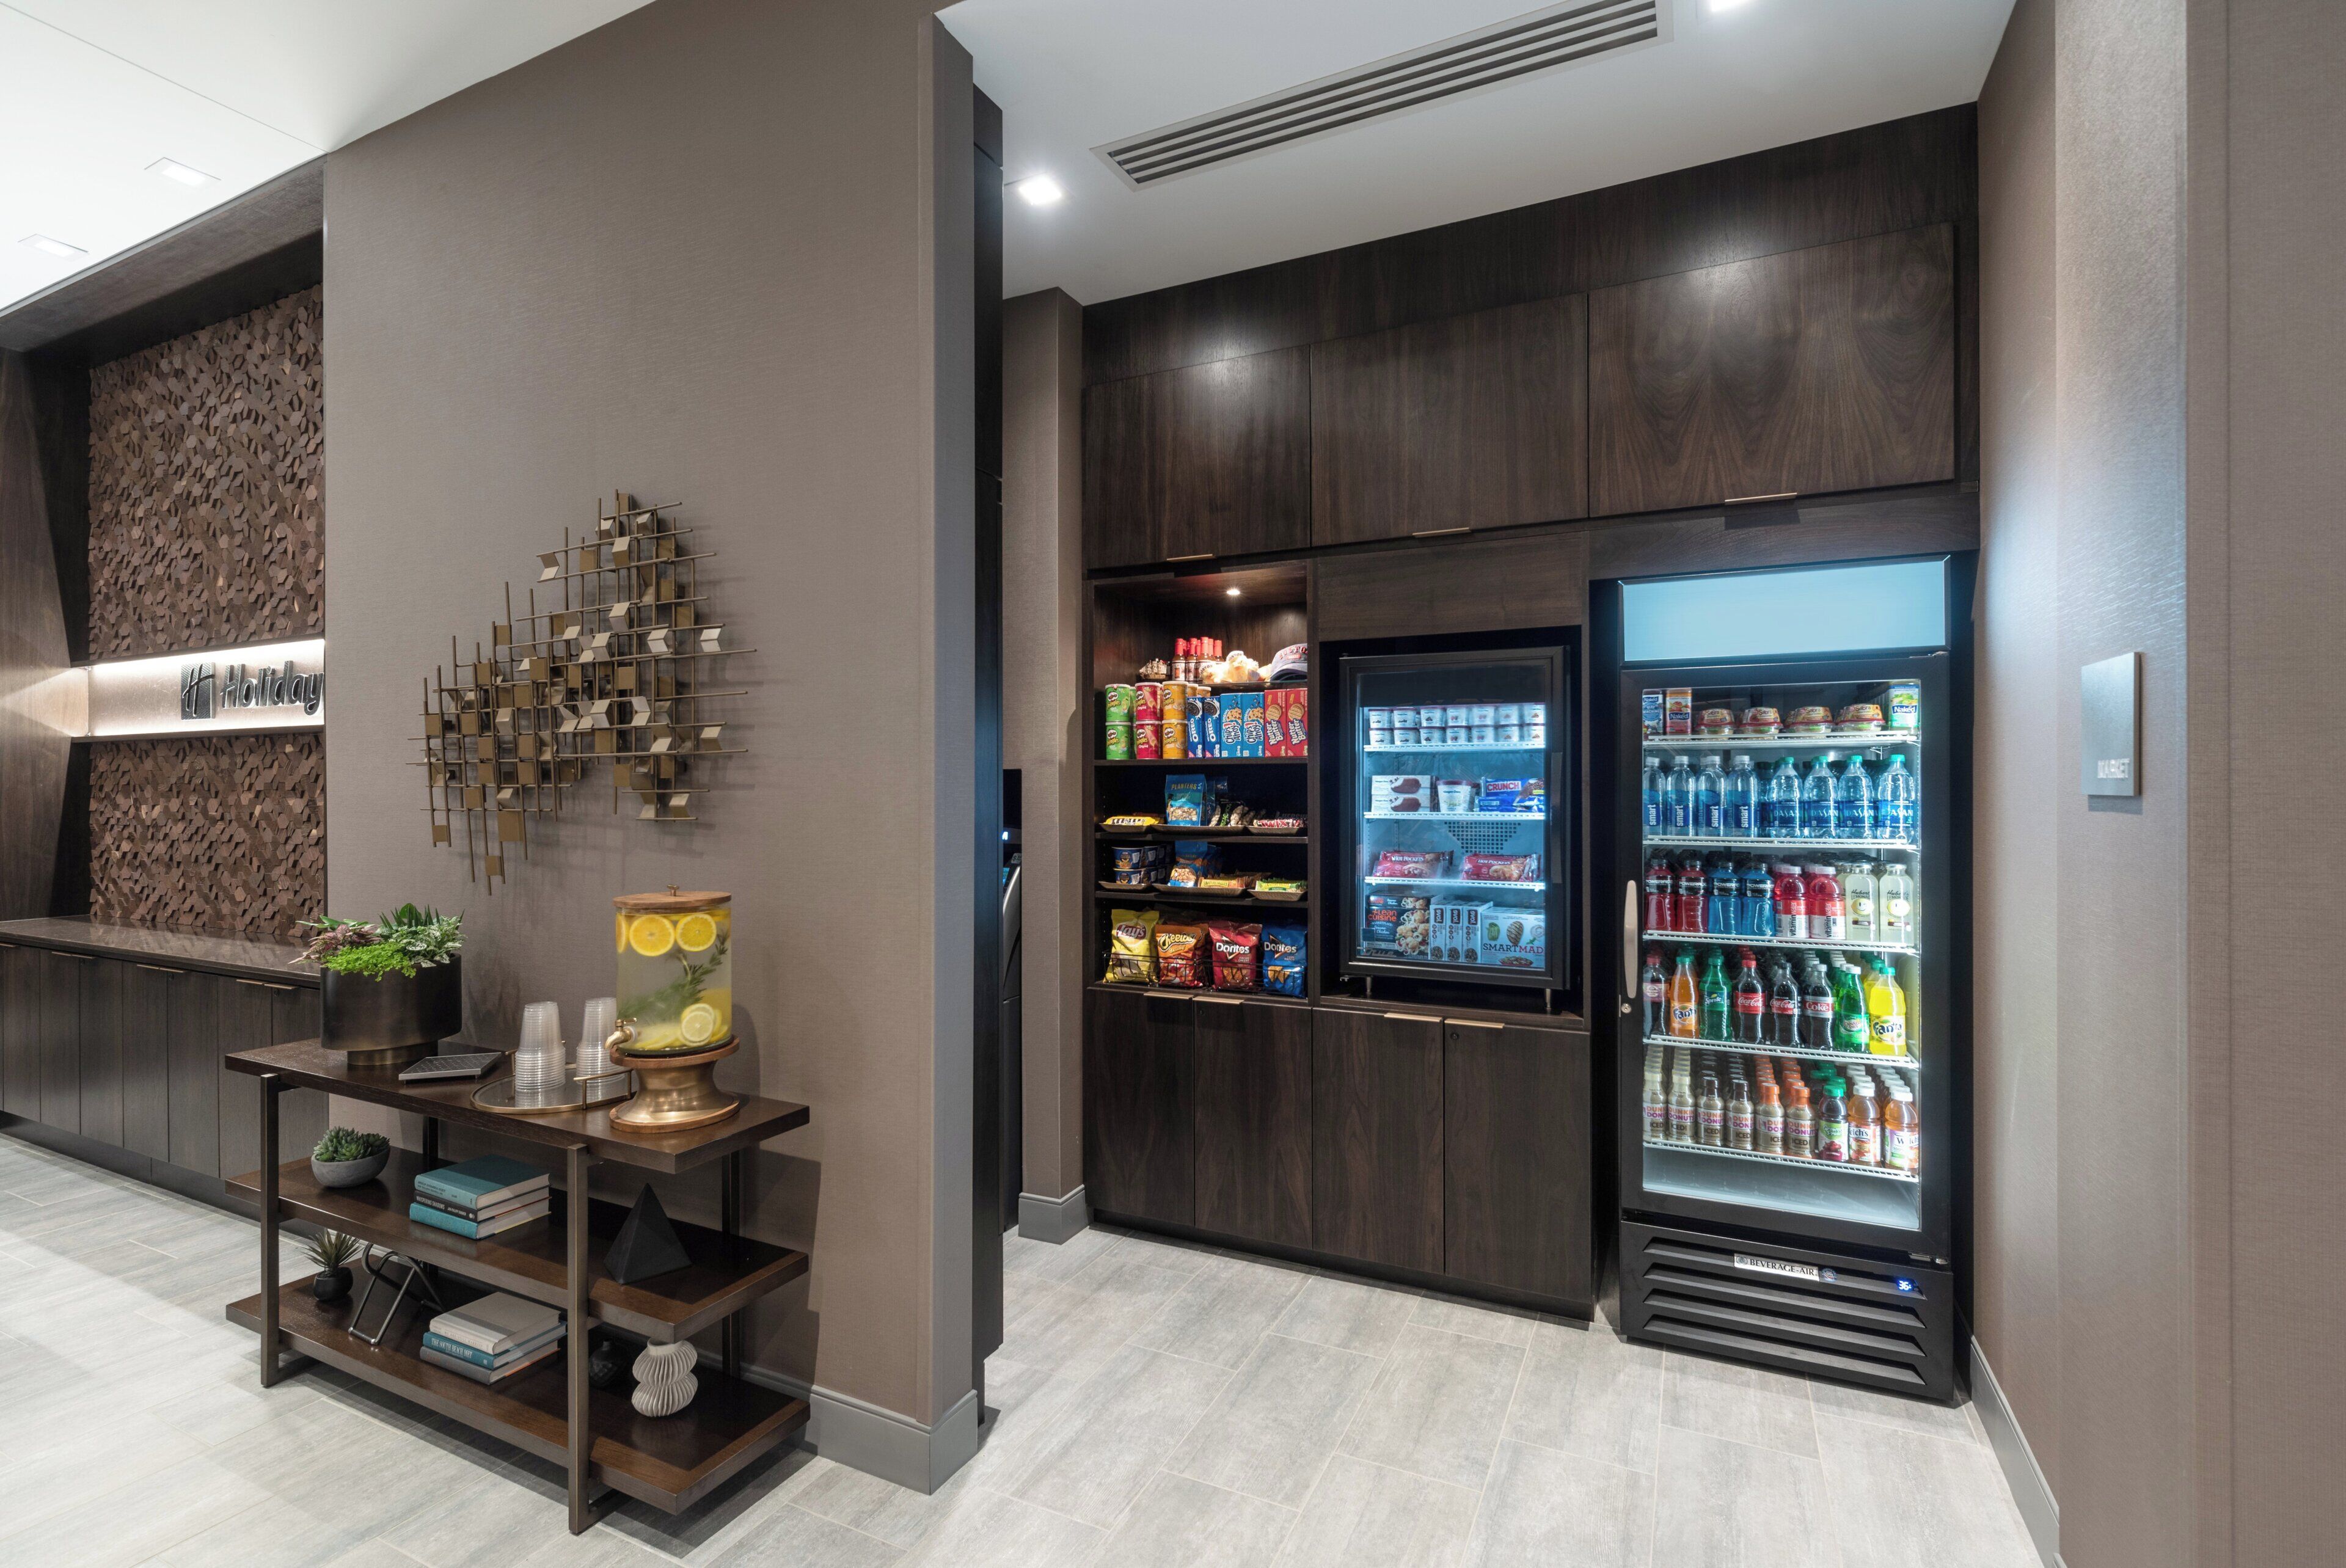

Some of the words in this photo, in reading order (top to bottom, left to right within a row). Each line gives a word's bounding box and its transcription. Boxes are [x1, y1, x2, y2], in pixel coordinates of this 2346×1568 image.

[221, 660, 324, 715] Holiday
[1225, 726, 1235, 743] Chips
[1247, 726, 1256, 743] Chips
[1266, 723, 1277, 745] Nutter
[1271, 720, 1284, 741] Butter
[1288, 721, 1299, 745] Nutter
[1293, 718, 1306, 740] Butter
[2097, 758, 2130, 778] MARKET
[1486, 782, 1519, 791] CRUNCH
[1259, 820, 1288, 828] TWIX
[1648, 804, 1656, 826] smart
[1675, 805, 1684, 826] smart
[1710, 806, 1719, 827] smart
[1739, 806, 1749, 828] smart
[1120, 925, 1145, 939] Lay's
[1216, 943, 1250, 954] Doritos
[1264, 941, 1297, 953] Doritos
[1738, 997, 1763, 1007] Coca-Cola
[1770, 999, 1795, 1008] Coca-Cola
[1806, 1002, 1829, 1012] Coke
[416, 1195, 432, 1206] WHISPERING
[433, 1201, 445, 1210] SHADOWS
[1750, 1258, 1815, 1277] BEVERAGE-AIR
[439, 1340, 451, 1350] SOUTH
[451, 1344, 463, 1355] BEACH
[464, 1349, 473, 1358] DIET
